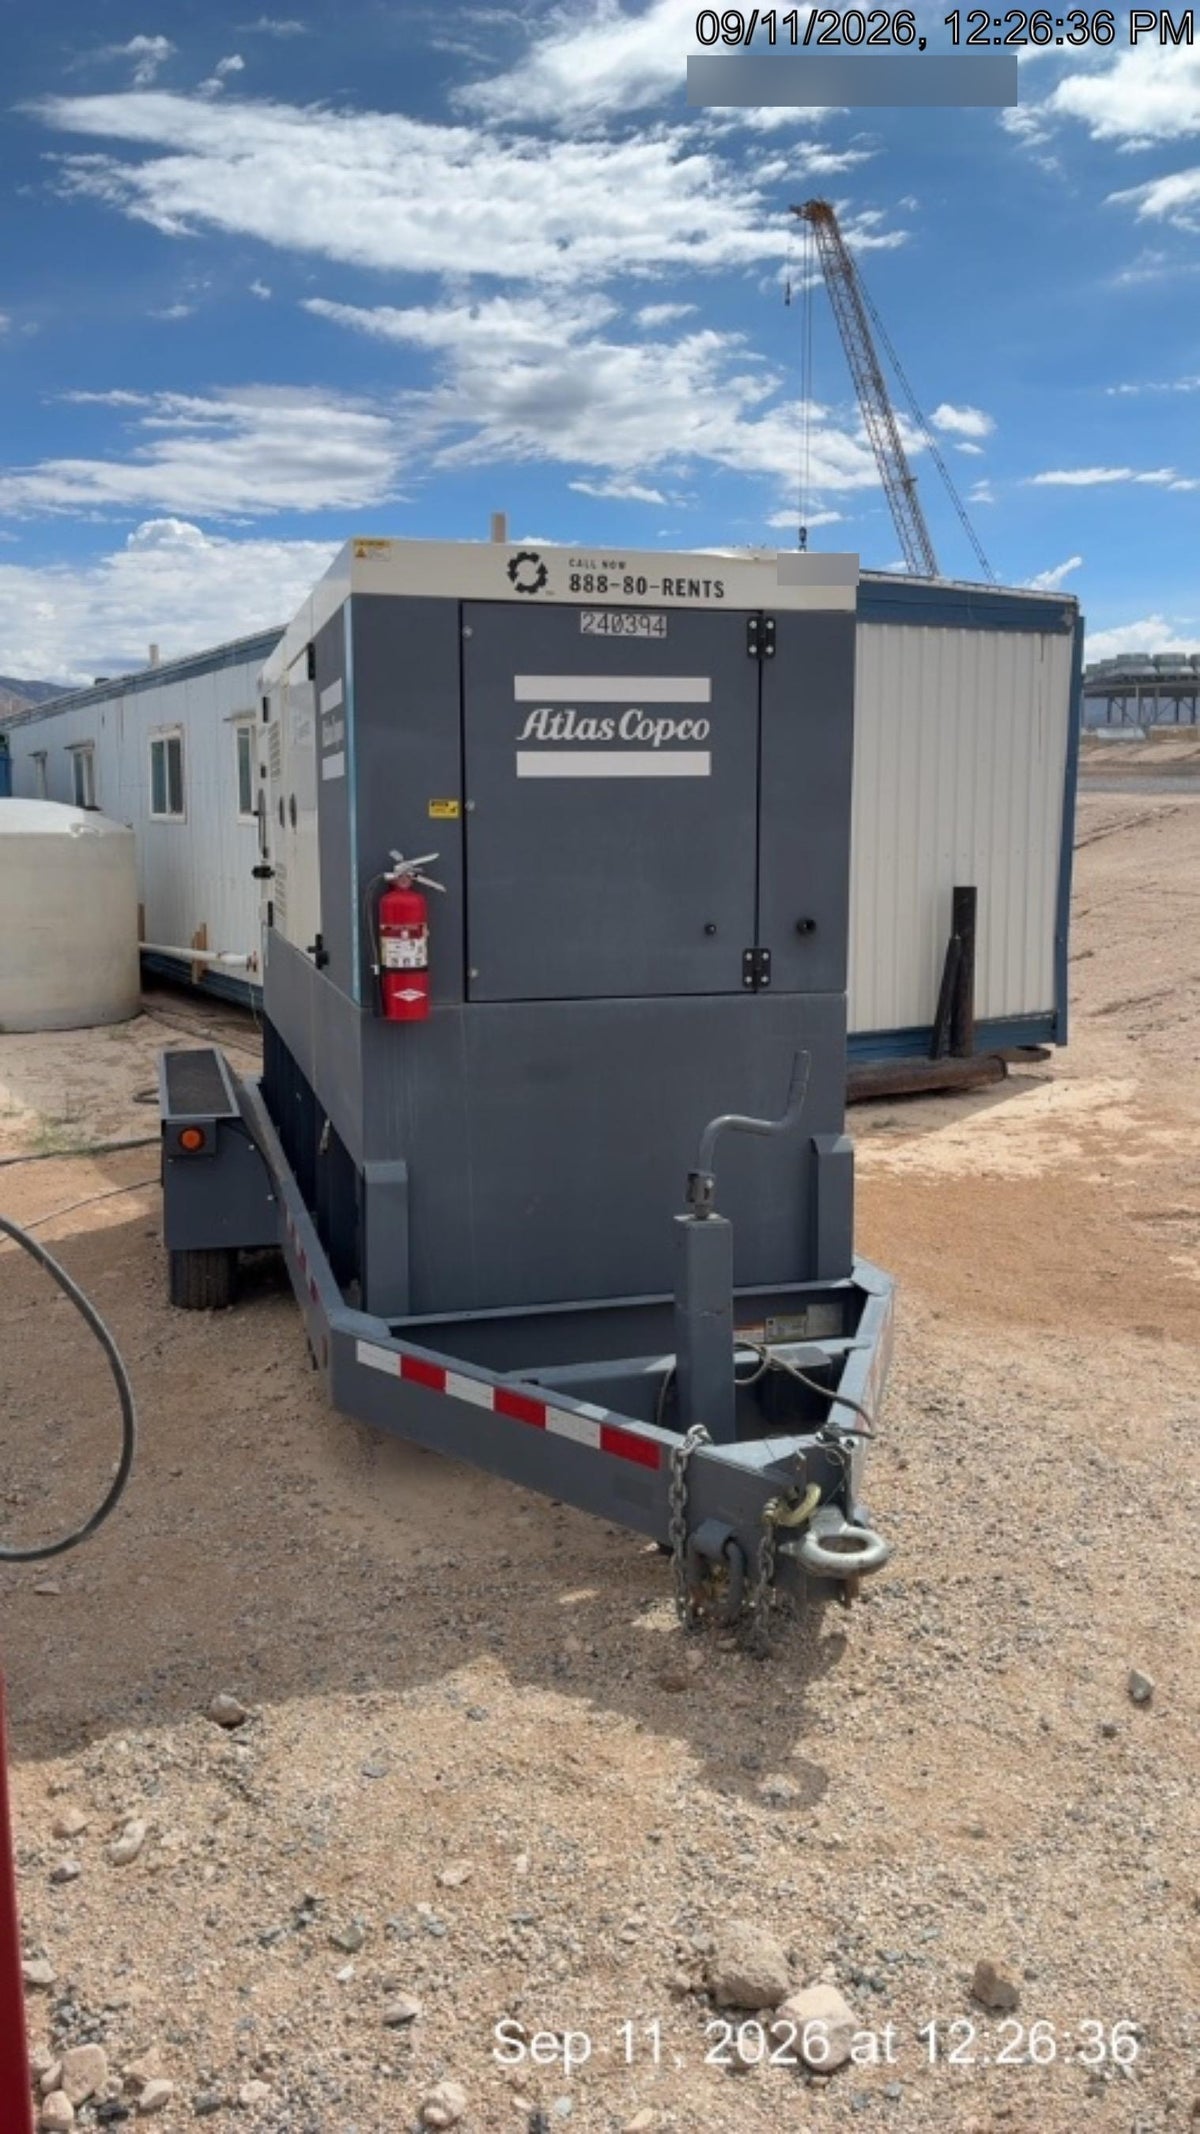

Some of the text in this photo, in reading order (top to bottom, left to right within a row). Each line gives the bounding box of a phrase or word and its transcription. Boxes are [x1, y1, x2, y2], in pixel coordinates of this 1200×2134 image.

[568, 557, 627, 571] CALL NOW
[568, 572, 725, 599] 888-80-RENTS
[582, 612, 667, 637] 240394
[516, 708, 711, 748] Atlas Copco
